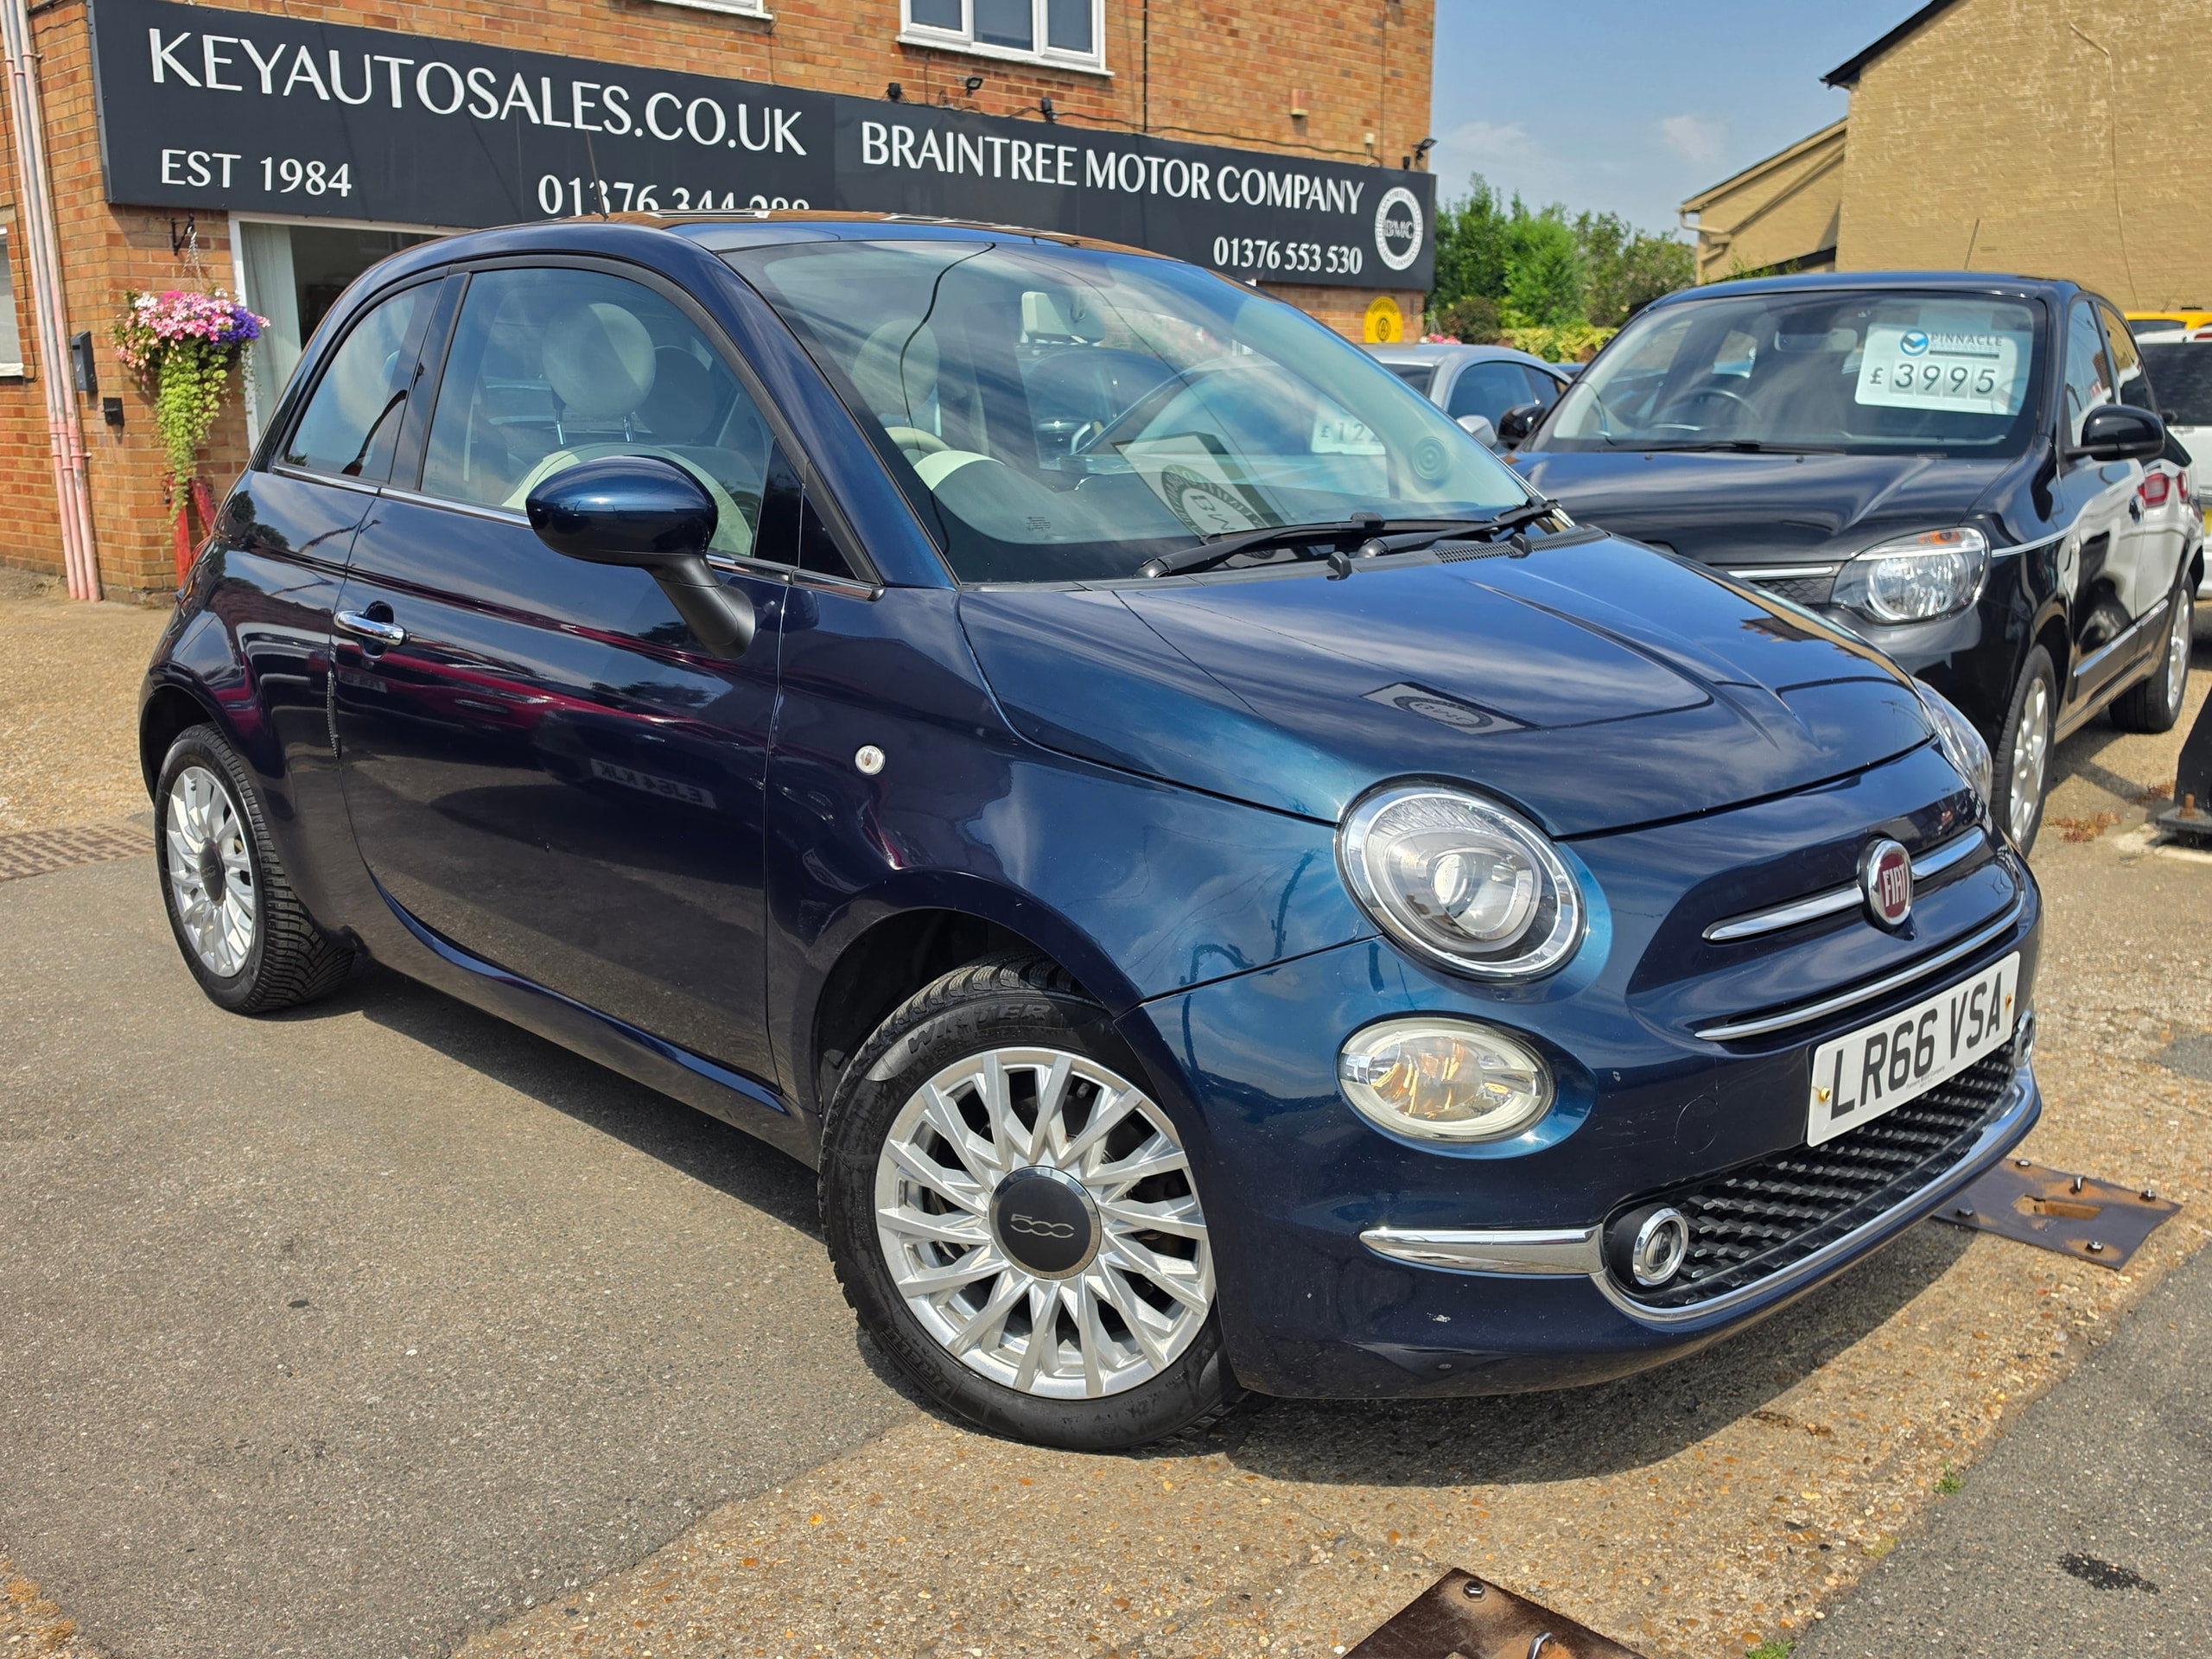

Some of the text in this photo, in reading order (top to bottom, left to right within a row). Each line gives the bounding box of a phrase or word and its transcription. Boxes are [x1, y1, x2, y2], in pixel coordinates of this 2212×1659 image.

[149, 28, 807, 156] KEYAUTOSALES.CO.UK
[162, 149, 353, 198] EST 1984
[861, 121, 1077, 186] BRAINTREE
[1085, 149, 1211, 200] MOTOR
[1217, 165, 1364, 214] COMPANY
[1385, 219, 1414, 239] BMC
[1213, 236, 1281, 270] 01376
[1284, 243, 1322, 272] 553
[1325, 245, 1363, 275] 530
[1929, 332, 2005, 347] PINNACLE
[1882, 862, 1906, 907] FIAT
[1830, 971, 2003, 1121] LR66 VSA
[1010, 1213, 1075, 1239] 500
